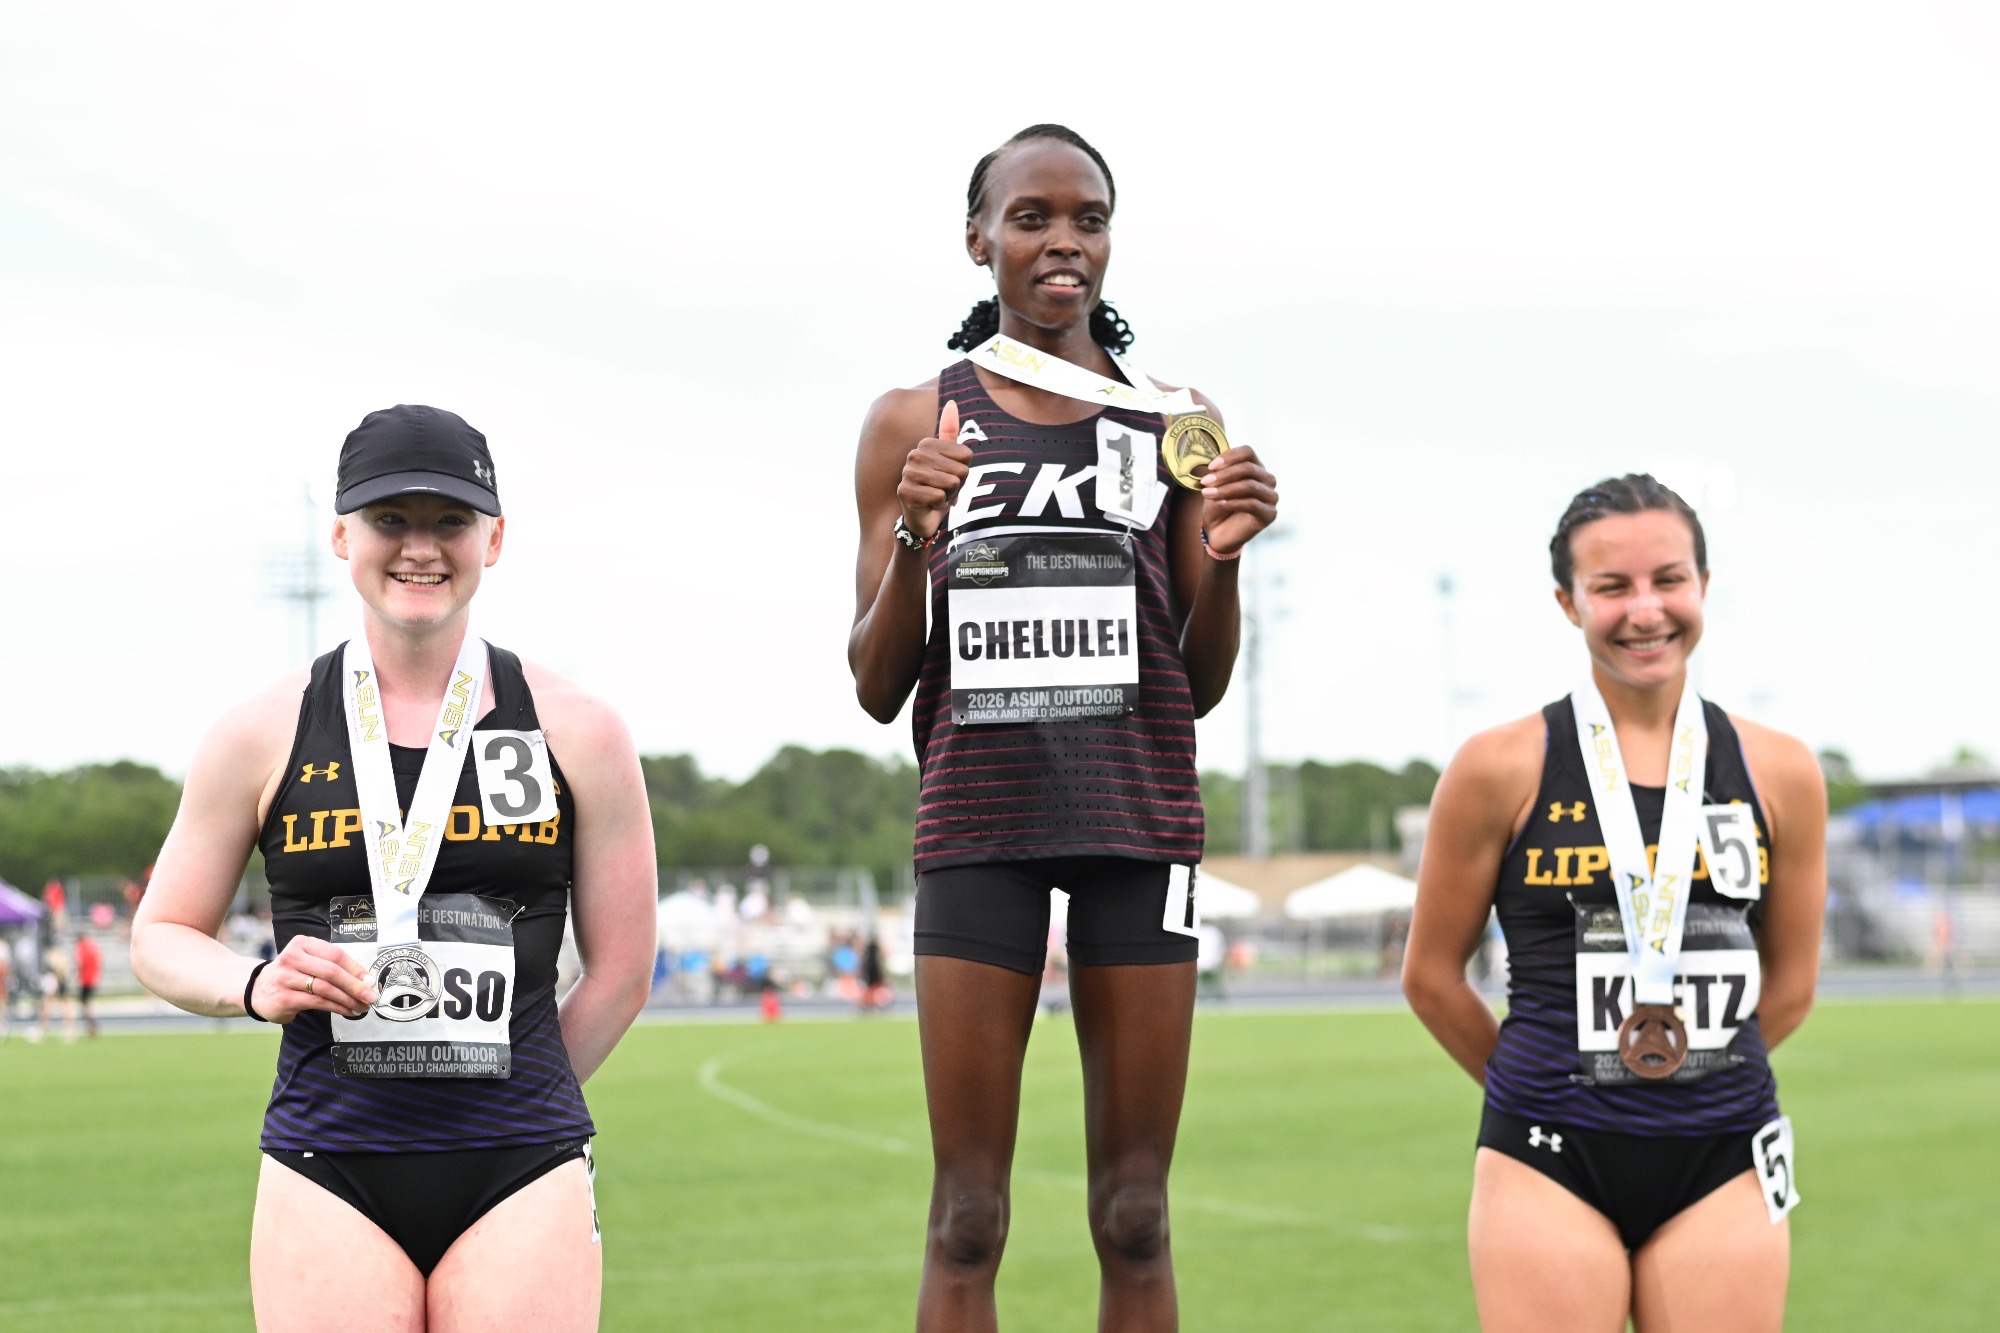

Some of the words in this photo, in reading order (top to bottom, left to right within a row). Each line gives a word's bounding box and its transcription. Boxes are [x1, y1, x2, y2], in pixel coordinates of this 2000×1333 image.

[1106, 432, 1133, 512] 1
[956, 566, 1009, 578] CHAMPIONSHIPS
[1026, 555, 1047, 569] THE
[1050, 554, 1126, 570] DESTINATION.
[958, 618, 1129, 661] CHELULEI
[967, 692, 1004, 709] 2026
[1009, 691, 1049, 707] ASUN
[1054, 688, 1123, 706] OUTDOOR
[438, 670, 473, 749] ASUN
[968, 709, 999, 720] TRACK
[1000, 709, 1019, 719] AND
[1022, 708, 1047, 718] FIELD
[1049, 705, 1123, 717] CHAMPIONSHIPS
[484, 736, 542, 818] 3
[1706, 814, 1751, 889] 5
[432, 910, 504, 930] DESTINATION.
[373, 950, 398, 970] TRACK
[406, 950, 428, 964] FIELD
[1592, 974, 1746, 1031] KTZ
[346, 1046, 382, 1062] 2026
[387, 1046, 427, 1062] ASUN
[431, 1046, 498, 1063] OUTDOOR
[1594, 1053, 1622, 1071] 202
[348, 1064, 377, 1074] TRACK
[378, 1064, 397, 1074] AND
[398, 1064, 425, 1074] FIELD
[426, 1064, 498, 1074] CHAMPIONSHIPS
[1761, 1128, 1789, 1209] 5
